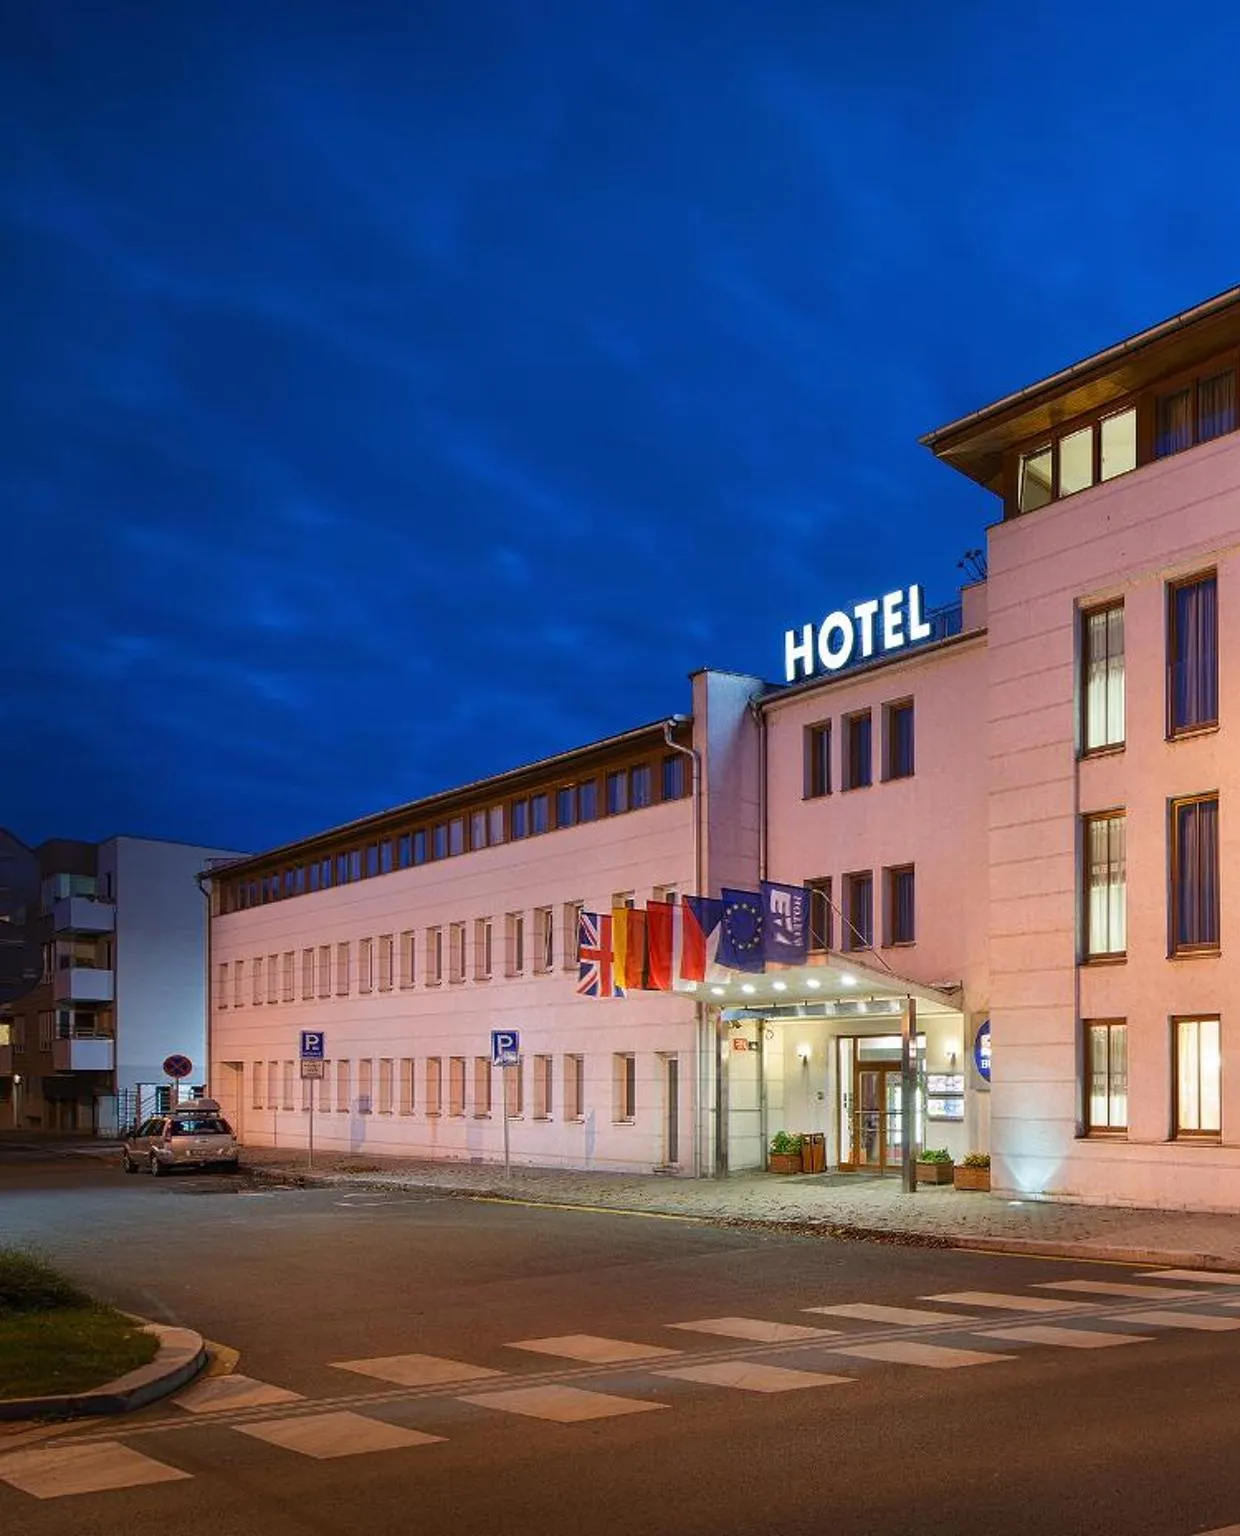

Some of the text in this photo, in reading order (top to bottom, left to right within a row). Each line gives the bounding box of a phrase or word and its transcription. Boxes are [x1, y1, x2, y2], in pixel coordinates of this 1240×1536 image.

[784, 583, 931, 682] HOTEL
[305, 1034, 320, 1051] P
[496, 1034, 513, 1056] P
